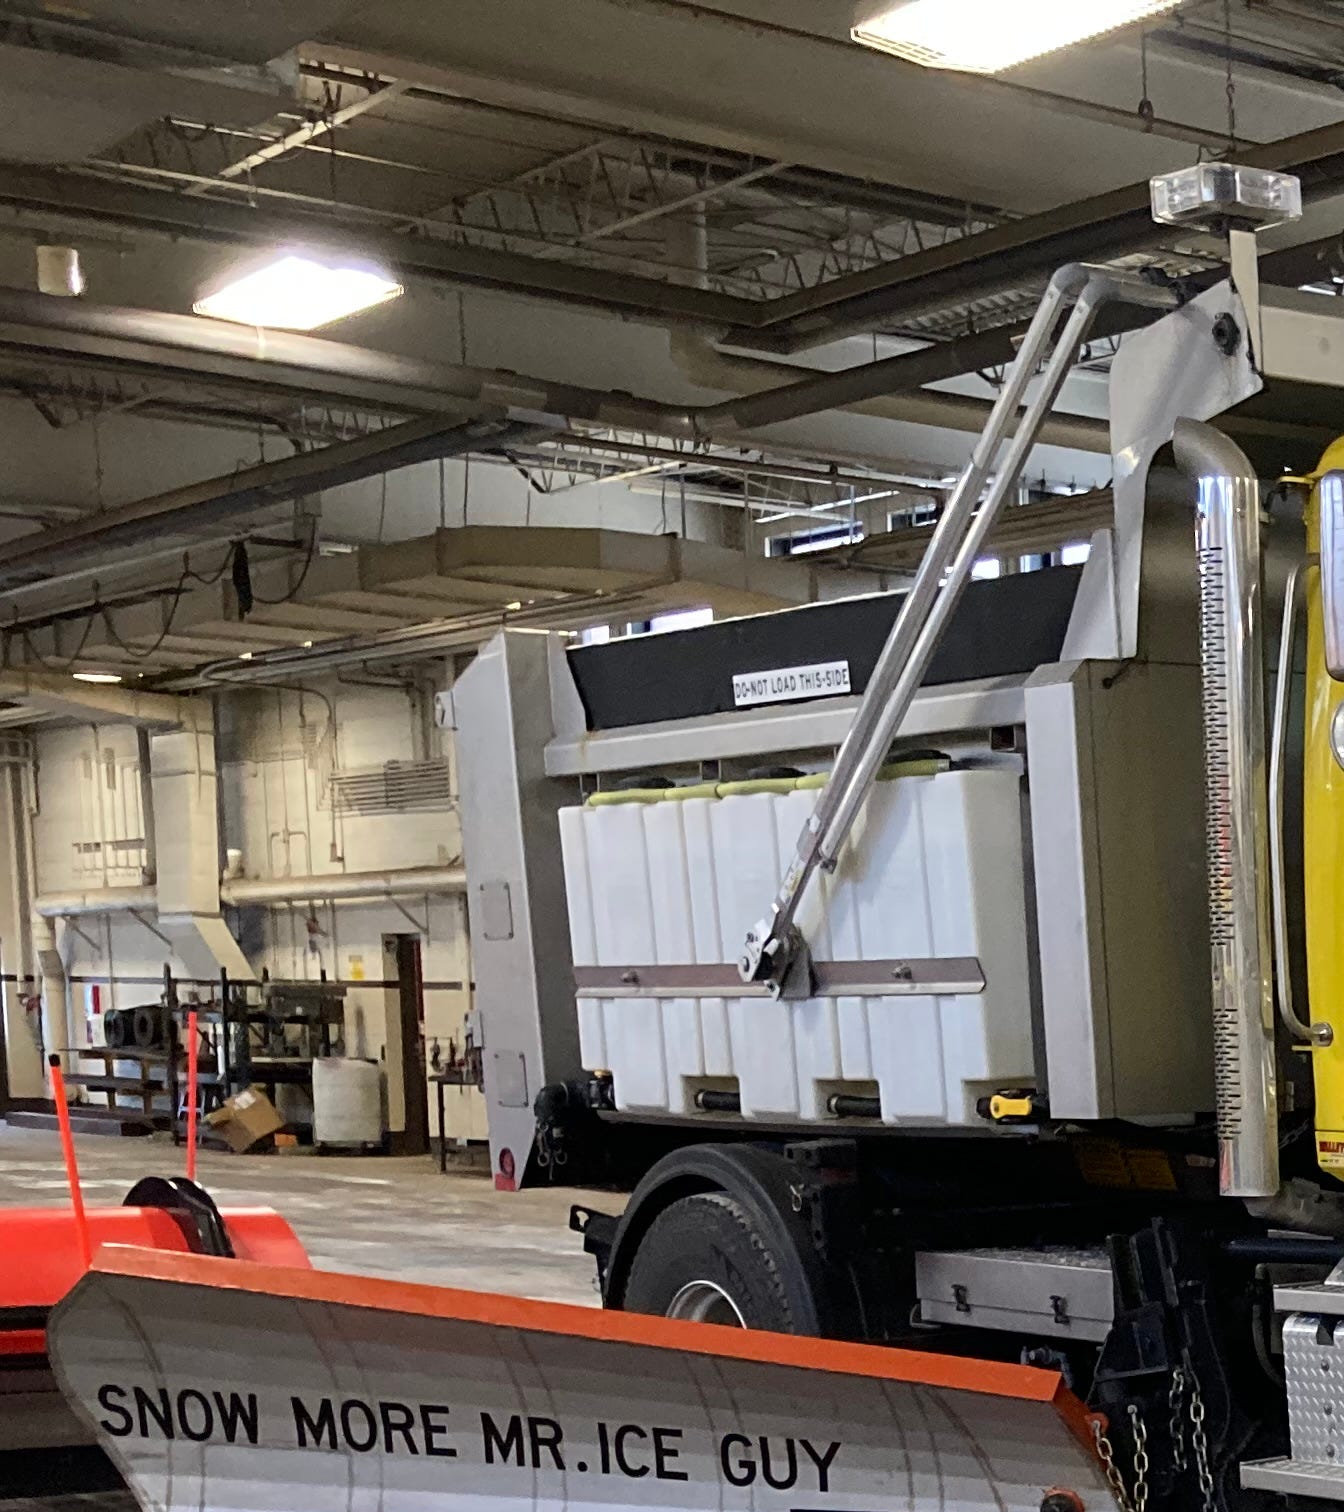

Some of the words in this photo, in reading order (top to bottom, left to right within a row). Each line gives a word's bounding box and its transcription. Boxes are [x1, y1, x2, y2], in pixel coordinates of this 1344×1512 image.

[771, 675, 796, 694] LOAD
[98, 1384, 259, 1445] SNOW
[290, 1396, 458, 1458] MORE
[720, 1433, 842, 1492] GUY
